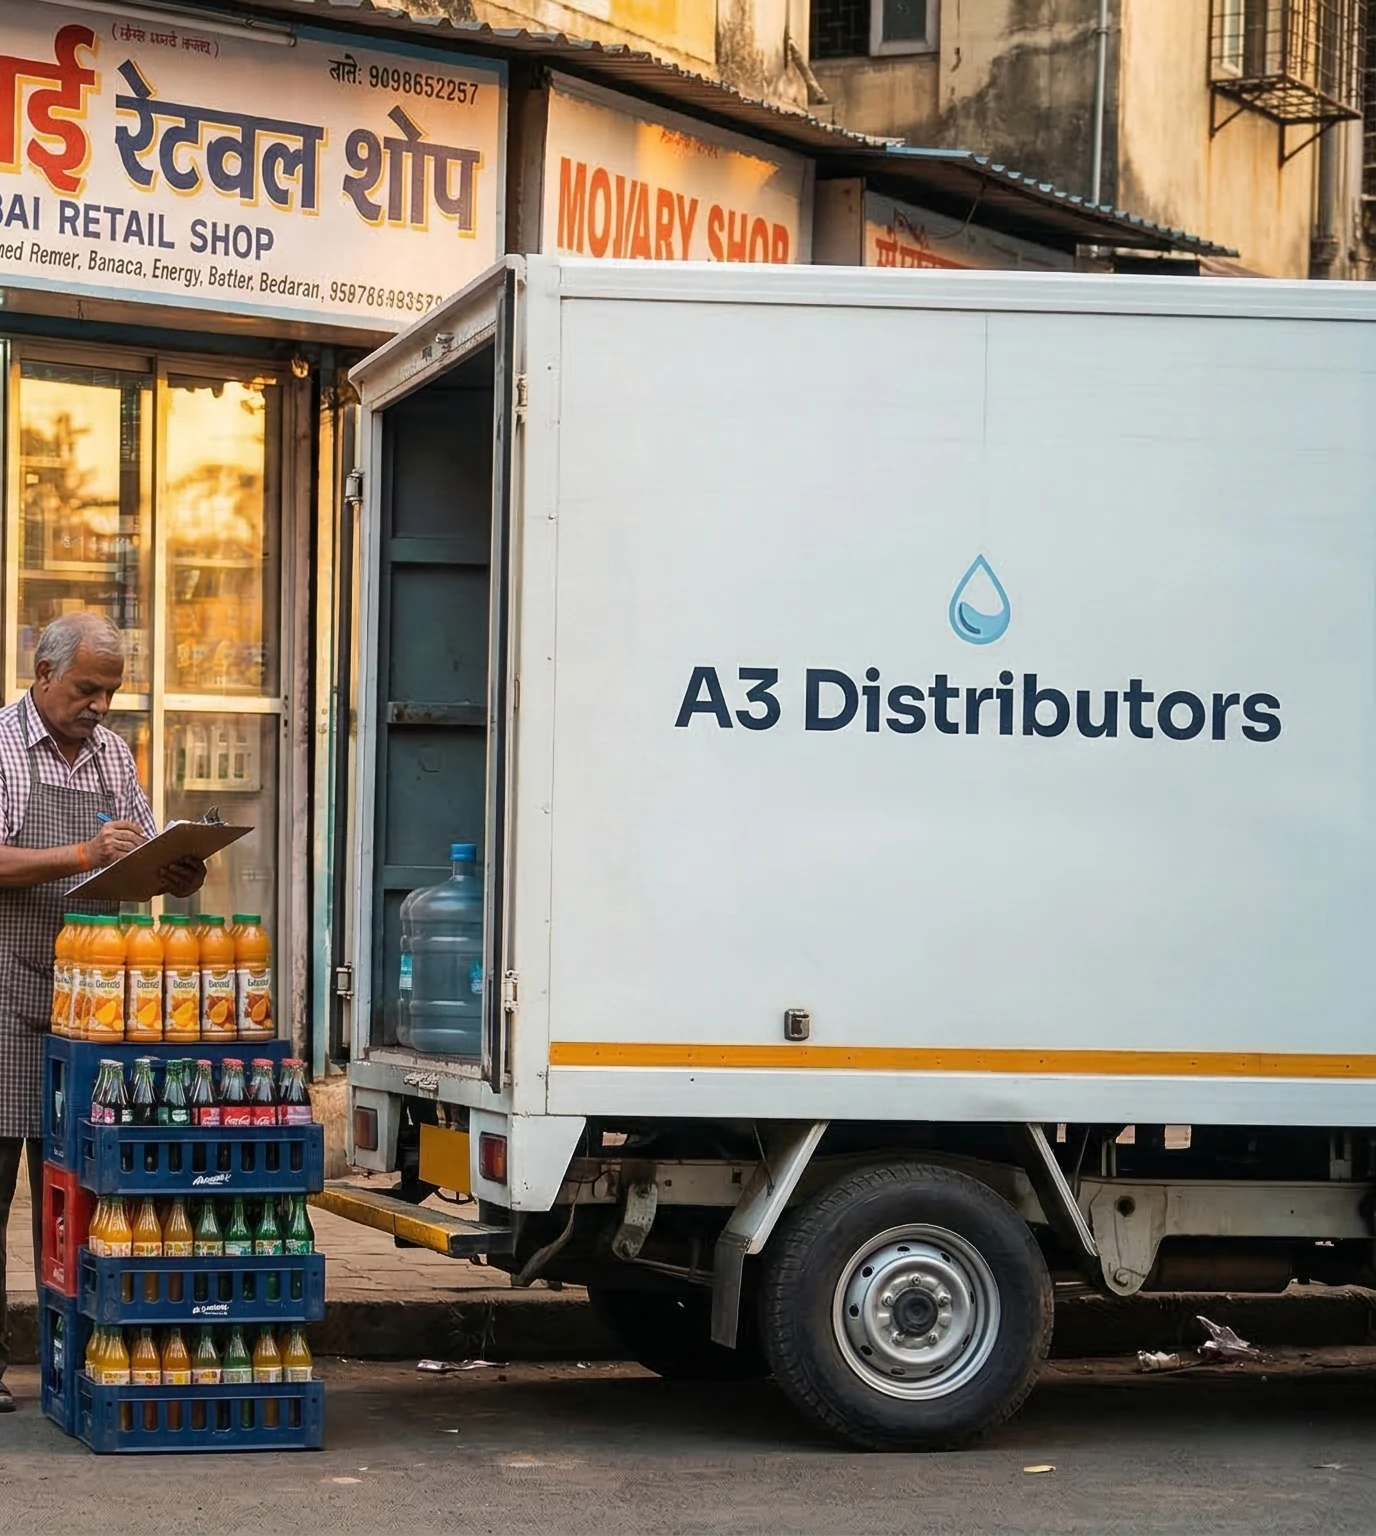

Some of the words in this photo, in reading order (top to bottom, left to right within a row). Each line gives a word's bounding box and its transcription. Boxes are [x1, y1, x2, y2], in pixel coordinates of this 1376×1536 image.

[369, 65, 478, 105] 9098652257
[115, 59, 327, 215] रेटवल
[342, 105, 482, 237] शोप
[58, 200, 175, 250] RETAIL
[189, 218, 275, 261] SHOP
[675, 666, 781, 731] A3
[804, 666, 1282, 742] Distributors
